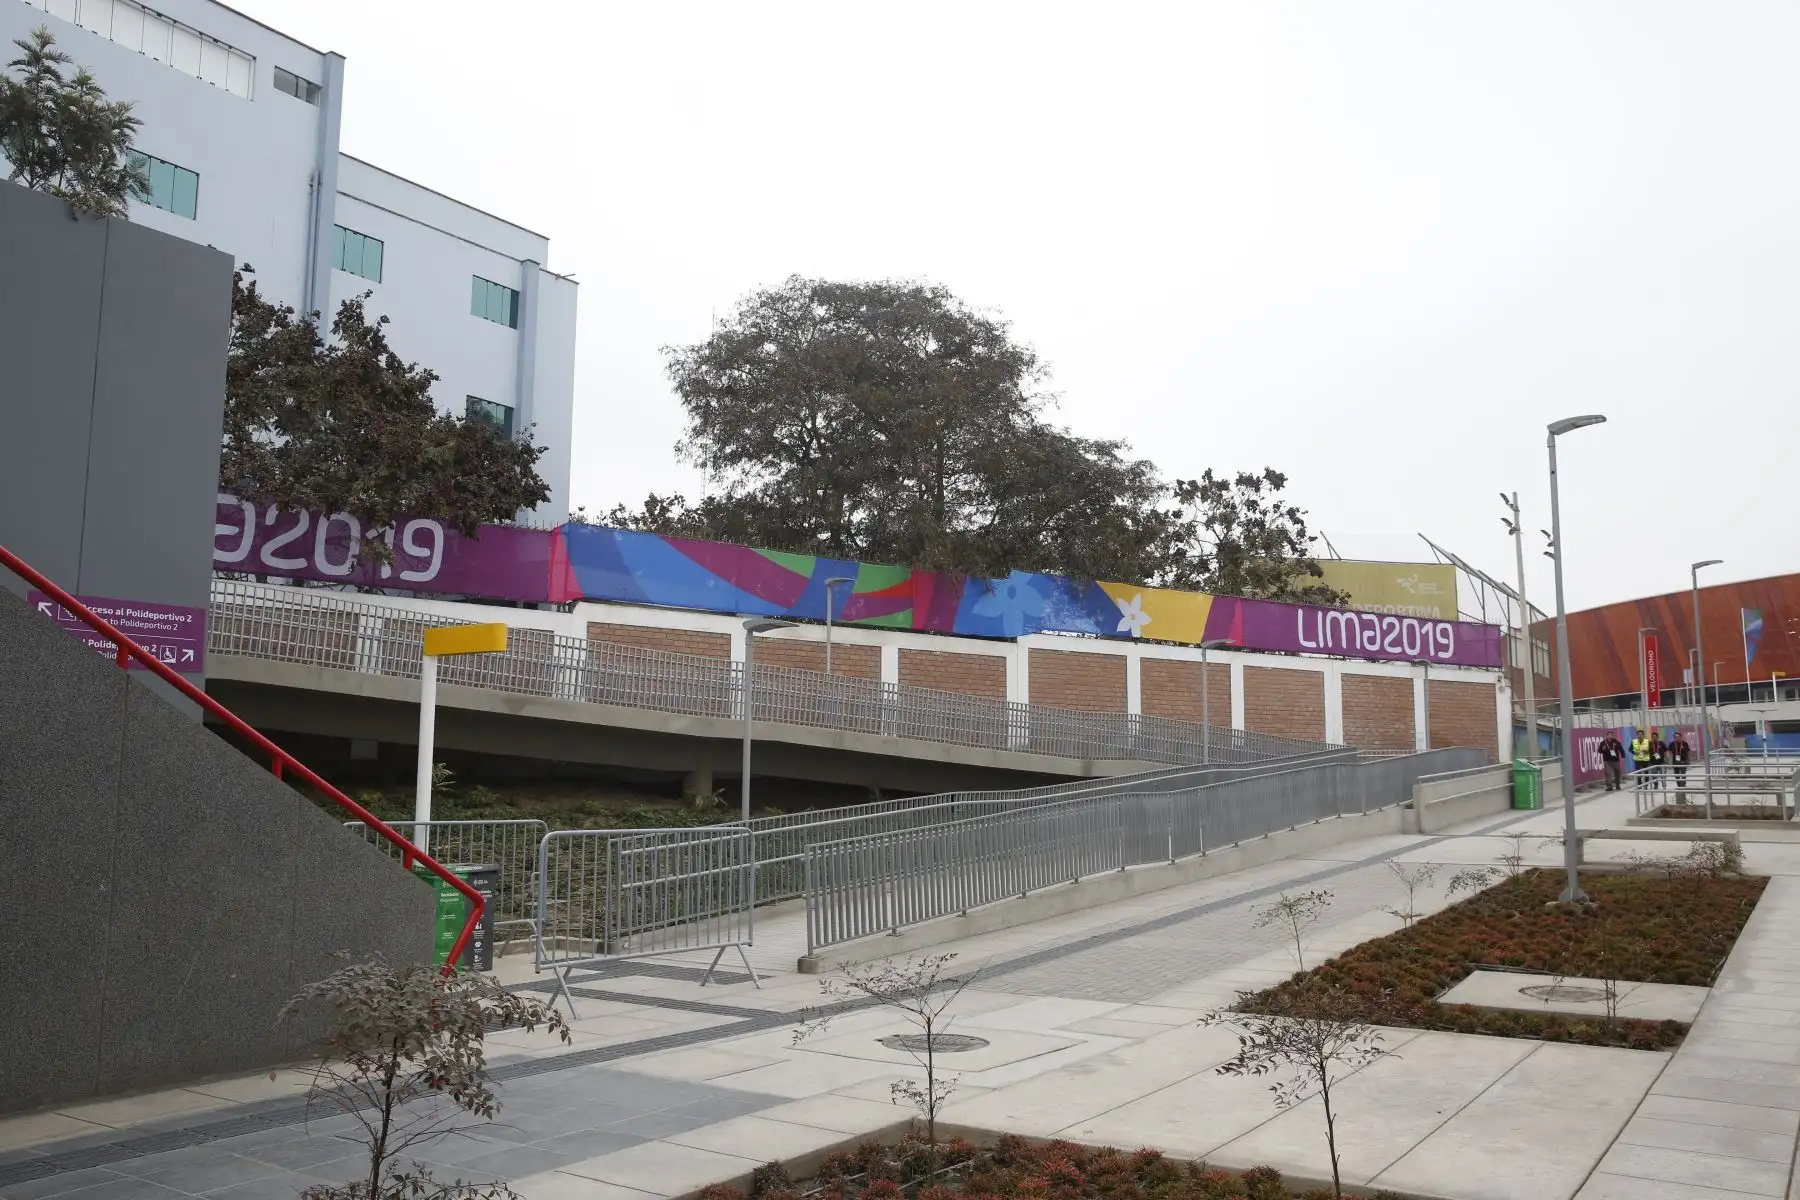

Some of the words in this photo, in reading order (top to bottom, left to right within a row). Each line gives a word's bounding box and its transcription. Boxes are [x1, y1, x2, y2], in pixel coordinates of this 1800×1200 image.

[81, 604, 114, 616] cceso
[115, 608, 124, 616] al
[126, 608, 185, 622] Polideportivo
[186, 614, 192, 622] 2
[110, 618, 119, 626] to
[120, 620, 172, 631] Polideportivo
[151, 644, 157, 652] 2
